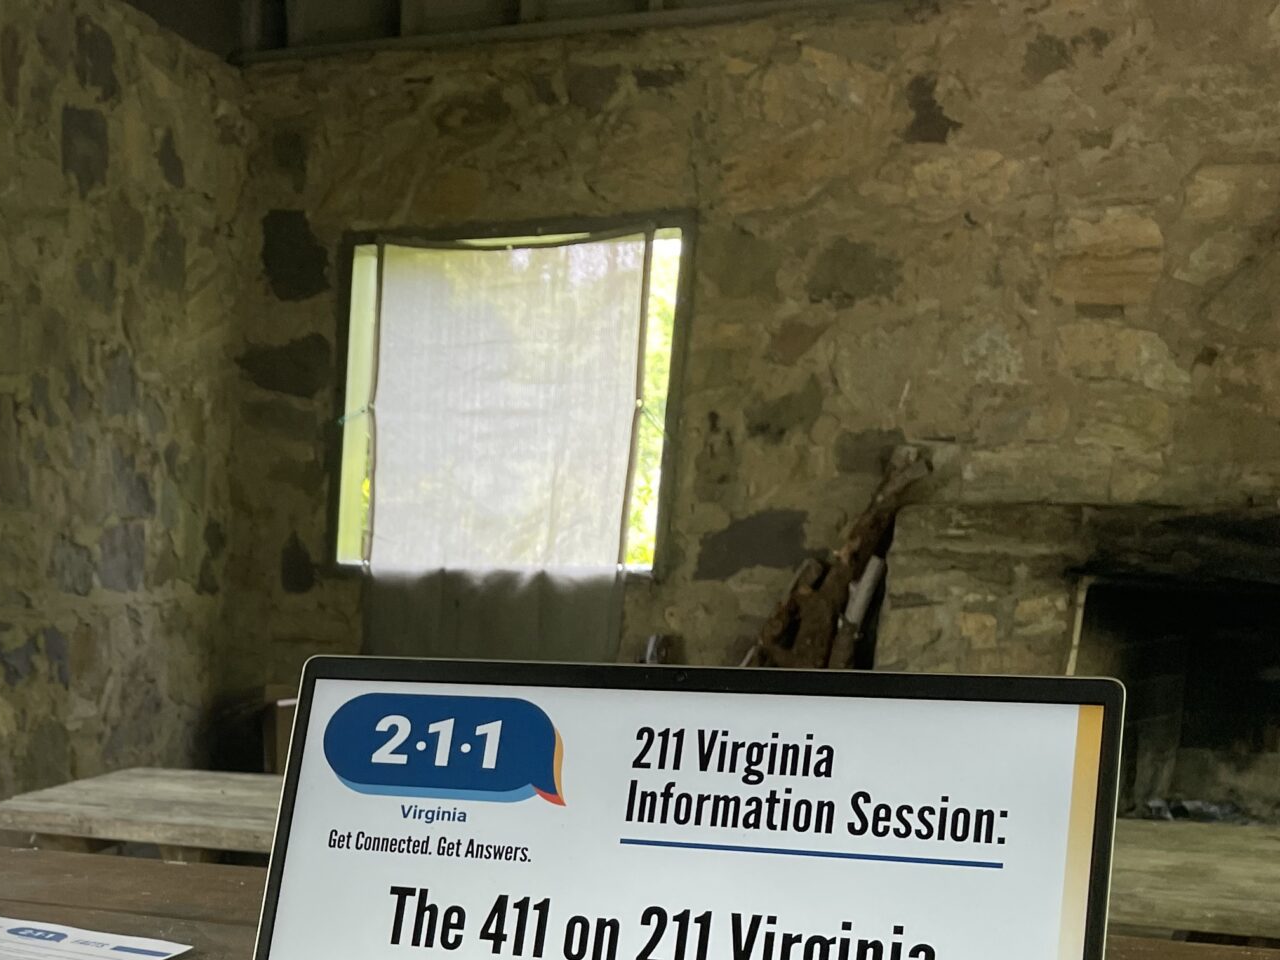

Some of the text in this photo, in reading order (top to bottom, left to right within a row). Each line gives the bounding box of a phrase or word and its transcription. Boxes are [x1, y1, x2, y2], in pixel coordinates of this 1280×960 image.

[631, 726, 835, 783] 211 Virginia
[400, 804, 467, 825] Virginia
[625, 779, 1009, 845] Information Session:
[327, 828, 532, 863] Get Connected. Get Answers.
[389, 885, 466, 951] The
[479, 894, 551, 959] 411
